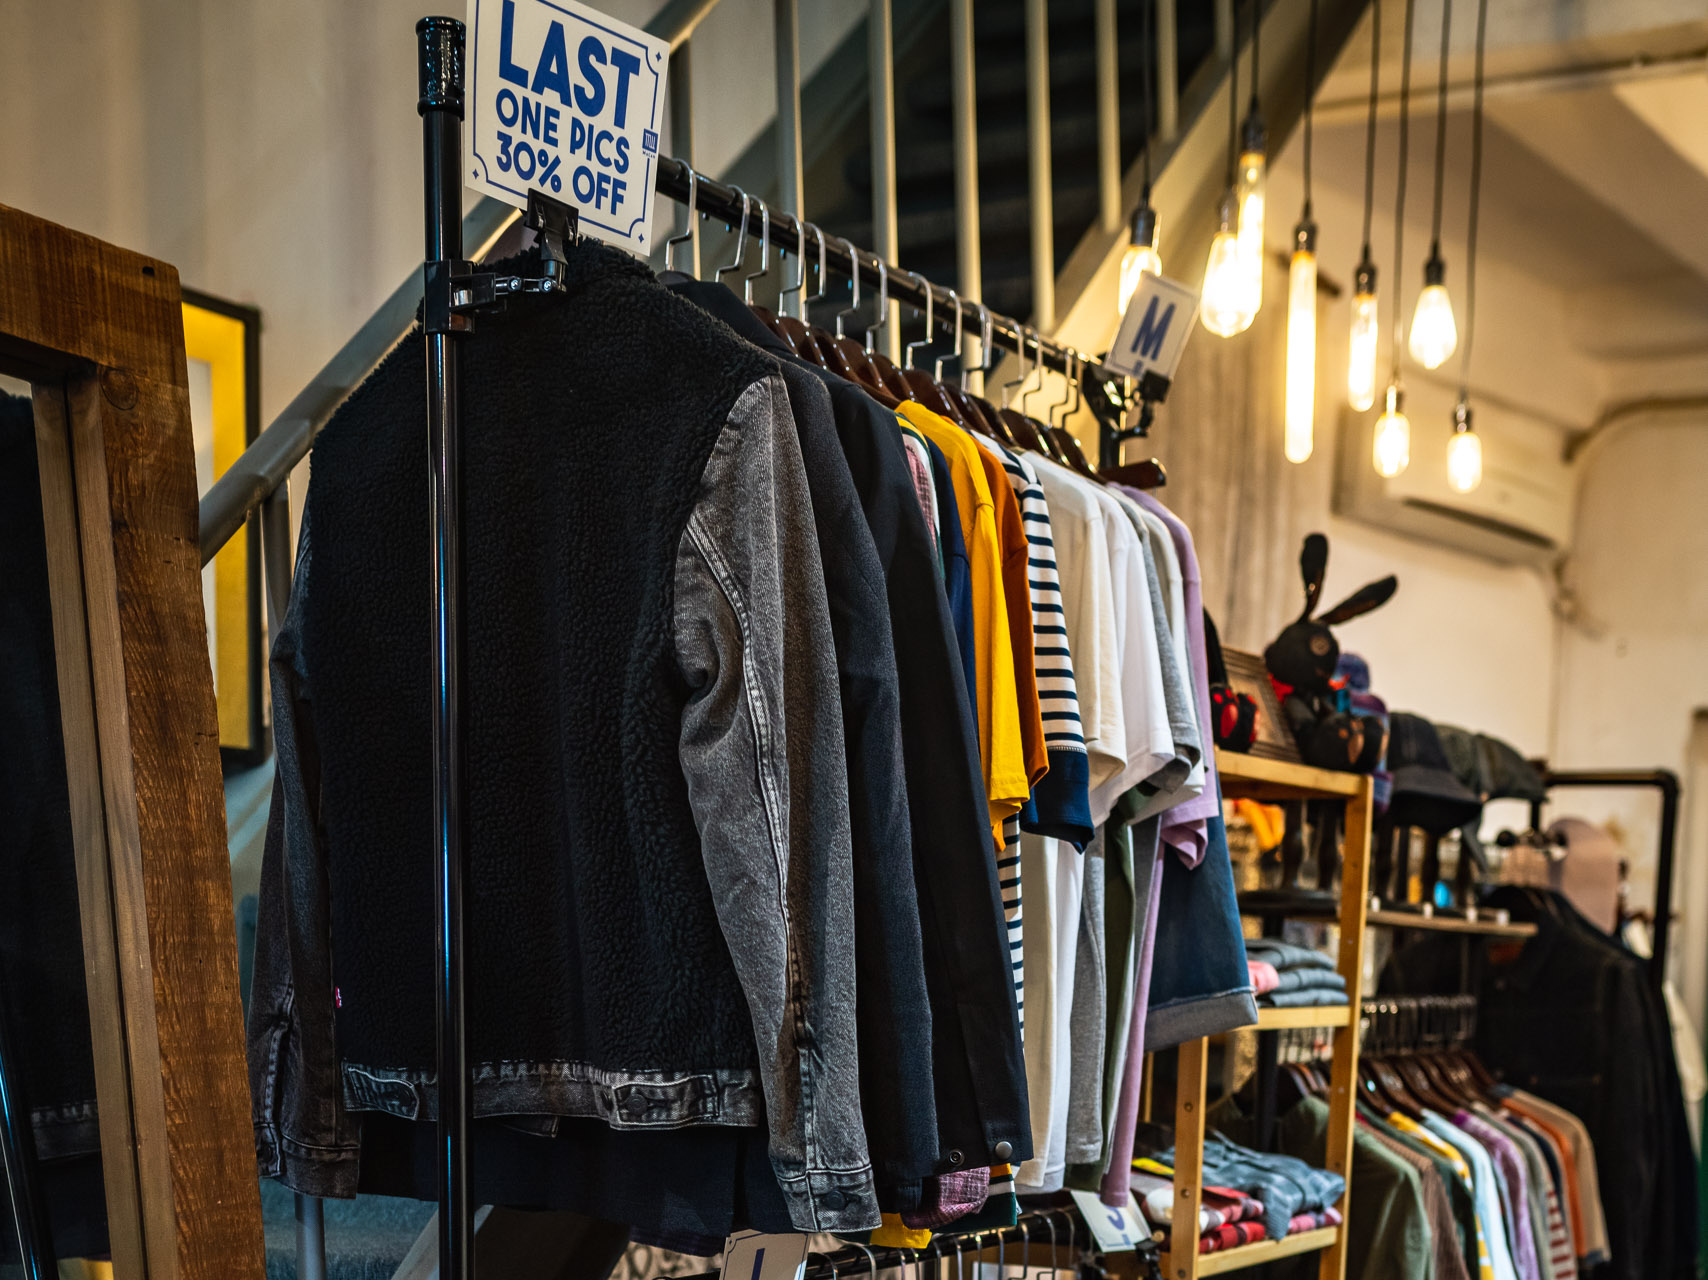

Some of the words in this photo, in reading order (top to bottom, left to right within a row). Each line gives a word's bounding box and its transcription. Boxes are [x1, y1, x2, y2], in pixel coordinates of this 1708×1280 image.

[499, 0, 641, 130] LAST
[496, 88, 560, 148] ONE
[569, 116, 630, 175] PICS
[496, 130, 562, 193] 30%
[572, 165, 627, 216] OFF
[1130, 295, 1175, 362] M
